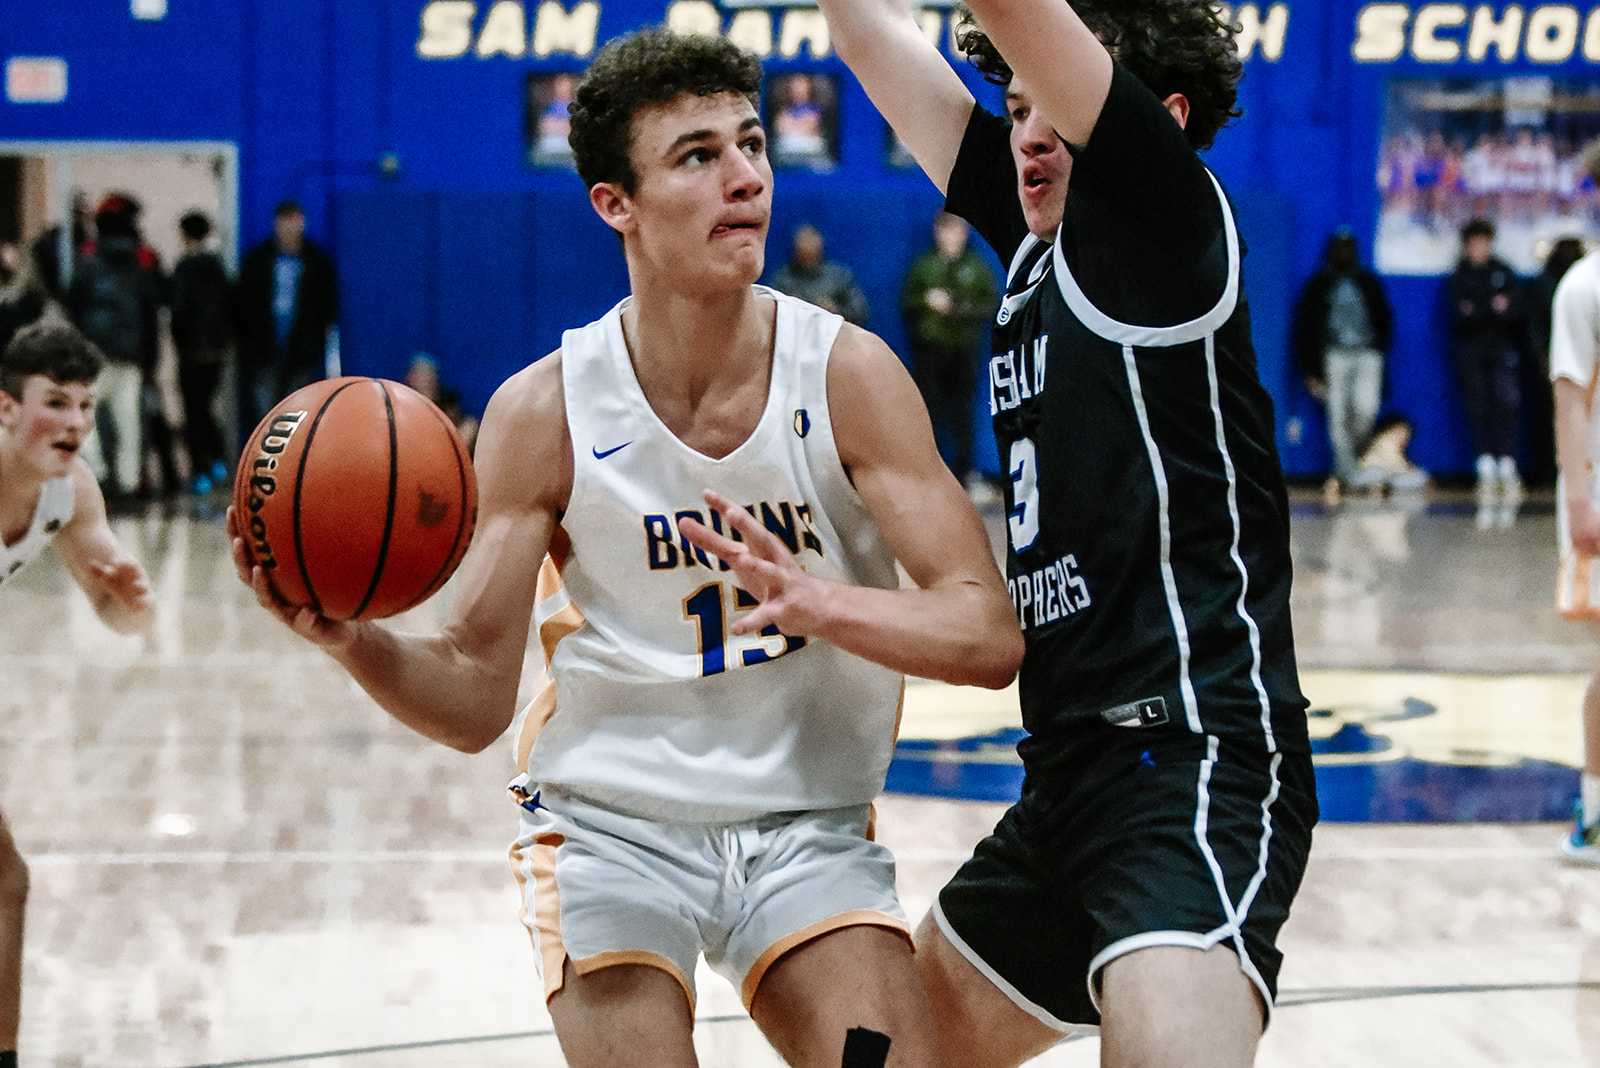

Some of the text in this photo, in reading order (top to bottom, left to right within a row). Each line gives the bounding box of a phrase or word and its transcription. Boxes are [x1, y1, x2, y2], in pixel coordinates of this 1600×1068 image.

[418, 1, 597, 58] SAM
[248, 410, 307, 569] Wilson
[1008, 436, 1040, 552] 3
[643, 501, 824, 572] BRNS
[1145, 704, 1158, 719] L
